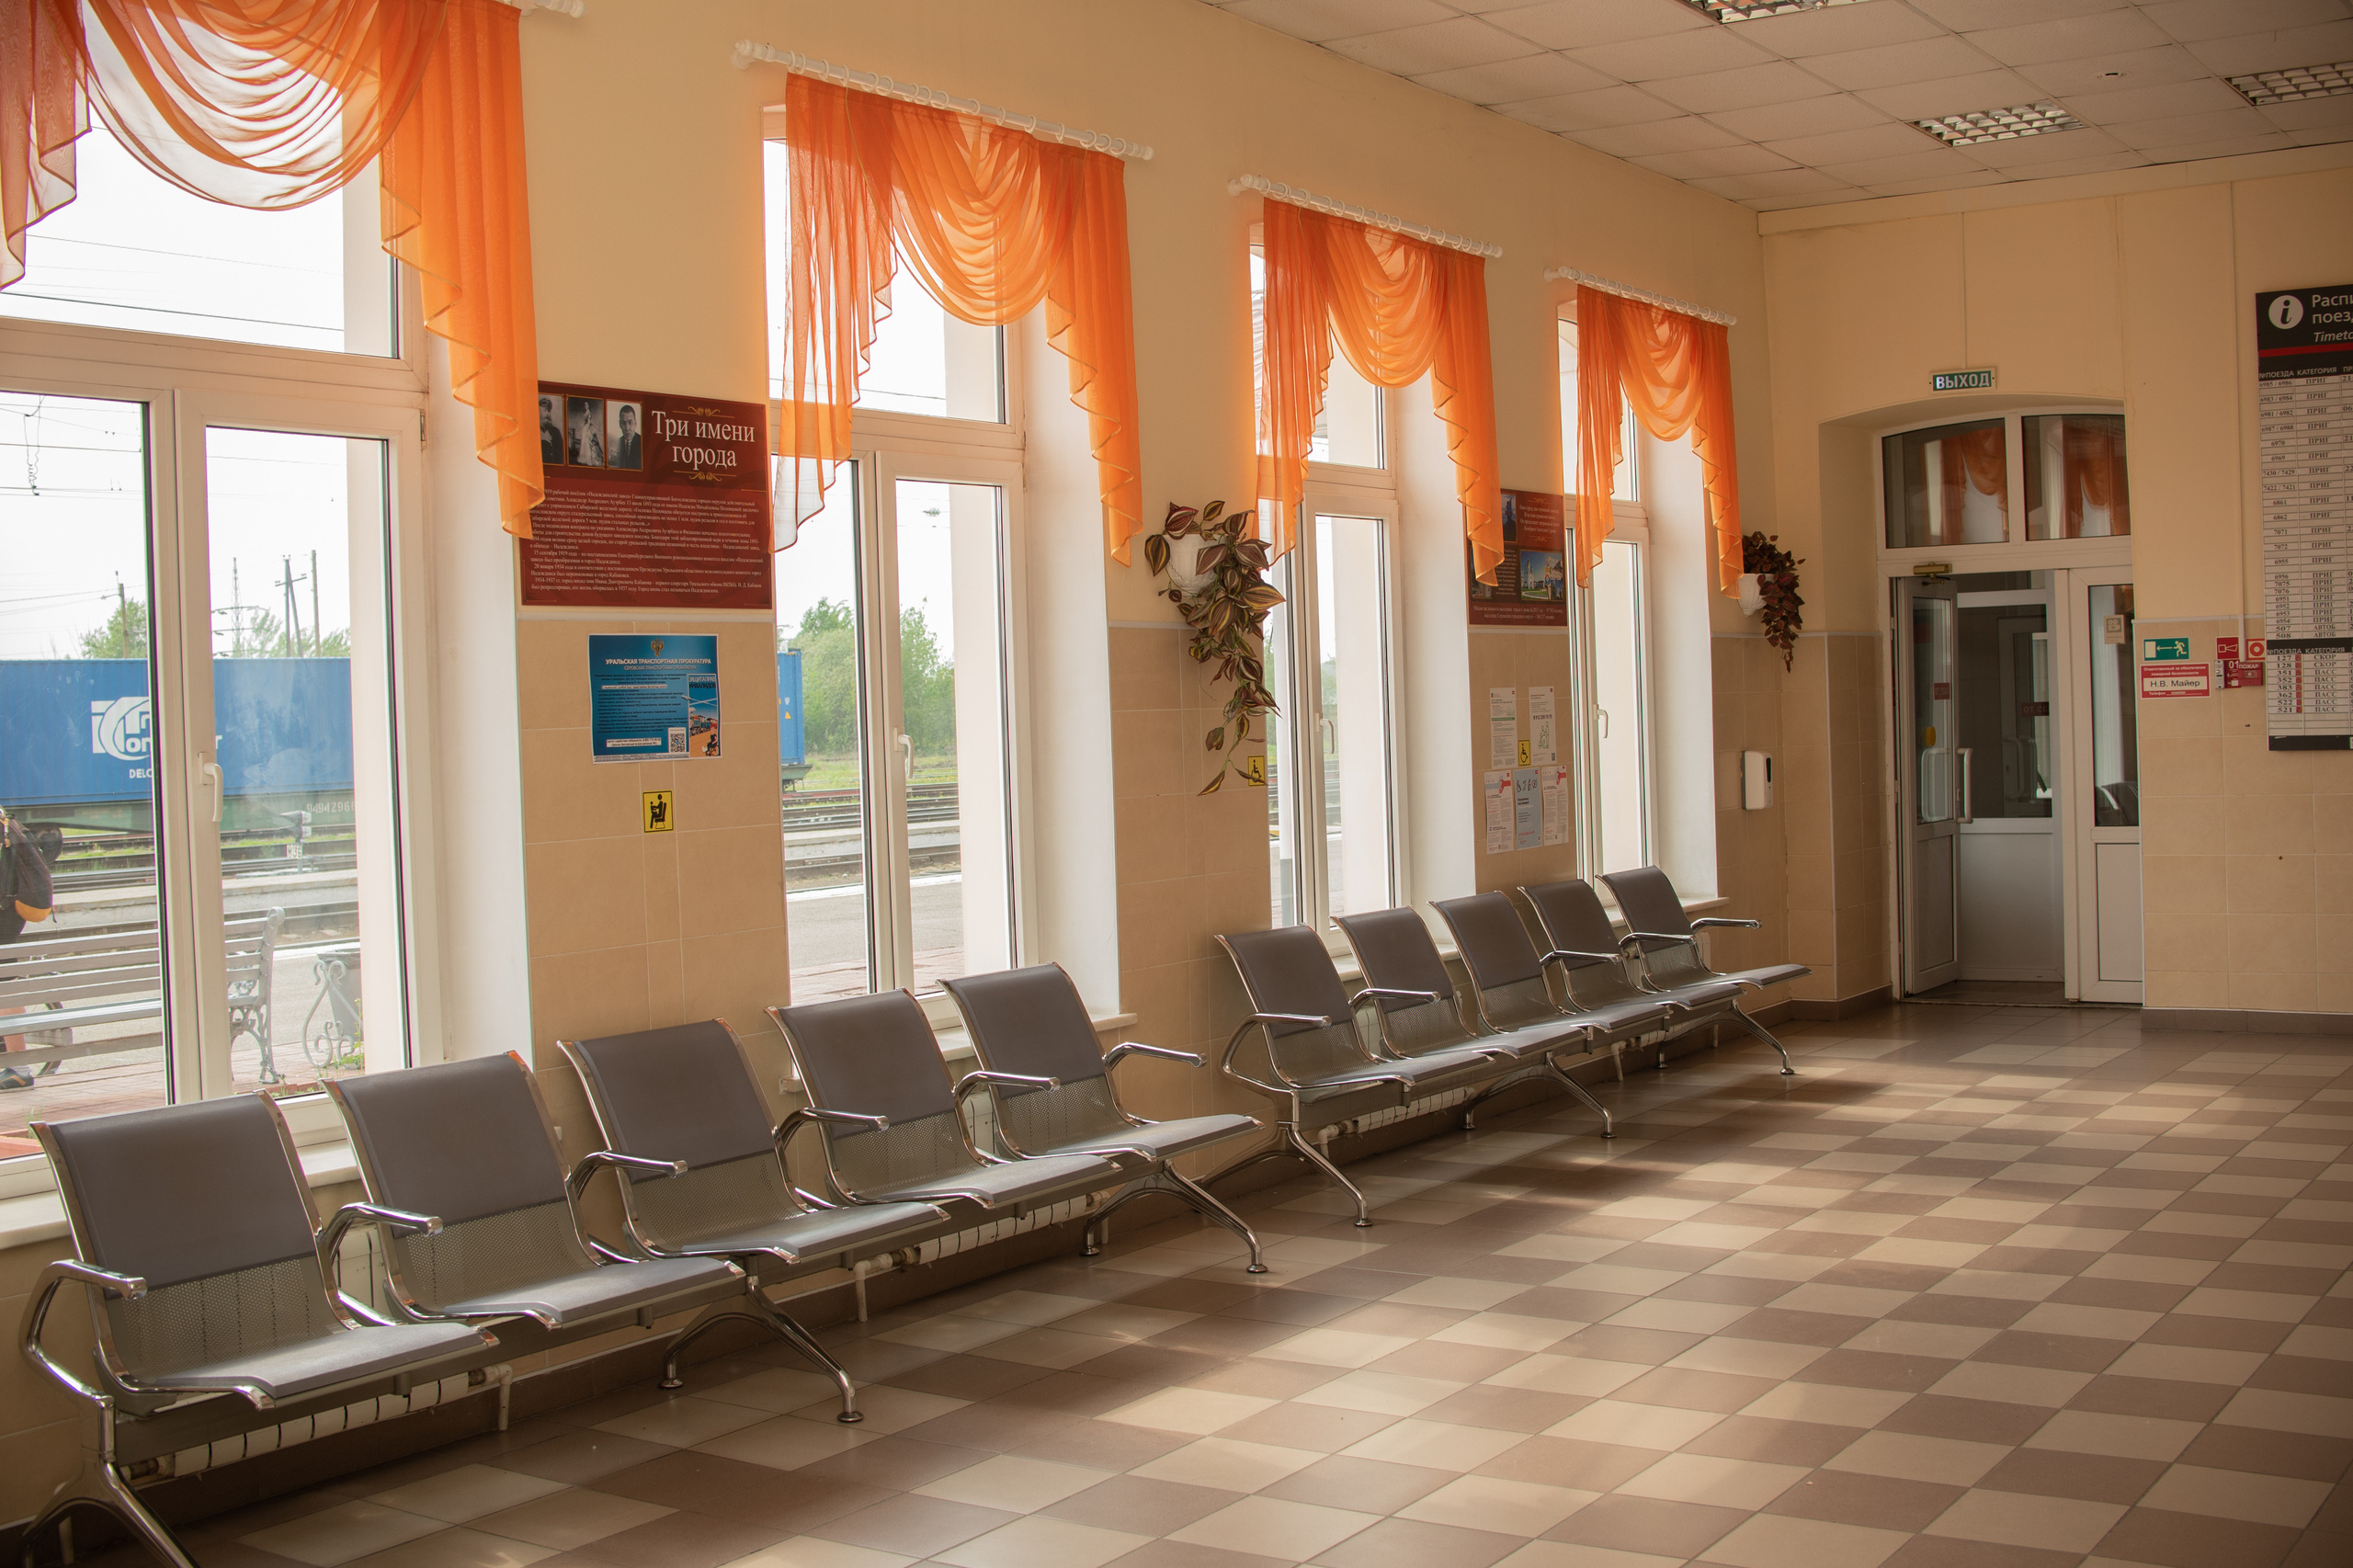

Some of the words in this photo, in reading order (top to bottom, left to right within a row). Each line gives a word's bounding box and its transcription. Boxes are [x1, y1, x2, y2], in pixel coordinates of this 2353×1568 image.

[2312, 295, 2353, 307] Расп
[2313, 312, 2353, 324] поез
[2297, 367, 2337, 375] КАТЕГОРИЯ
[1937, 373, 1990, 389] ВЫХОД
[652, 410, 688, 441] Три
[695, 423, 755, 443] имени
[672, 446, 737, 470] города
[2229, 660, 2239, 669] 01
